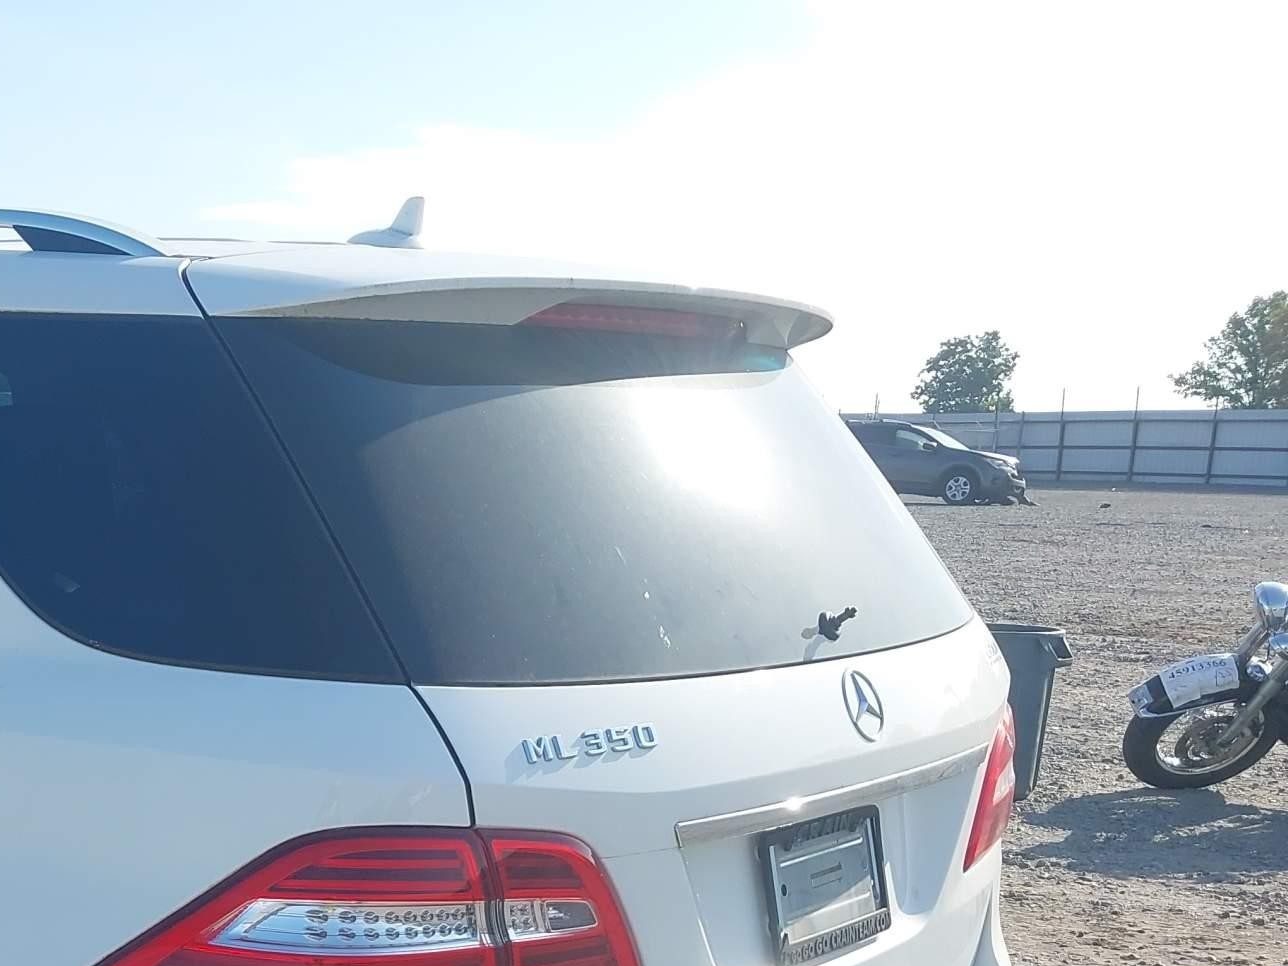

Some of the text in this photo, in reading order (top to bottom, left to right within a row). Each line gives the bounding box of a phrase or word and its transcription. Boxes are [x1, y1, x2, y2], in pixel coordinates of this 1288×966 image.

[521, 721, 658, 764] ML 350
[815, 936, 830, 954] GO
